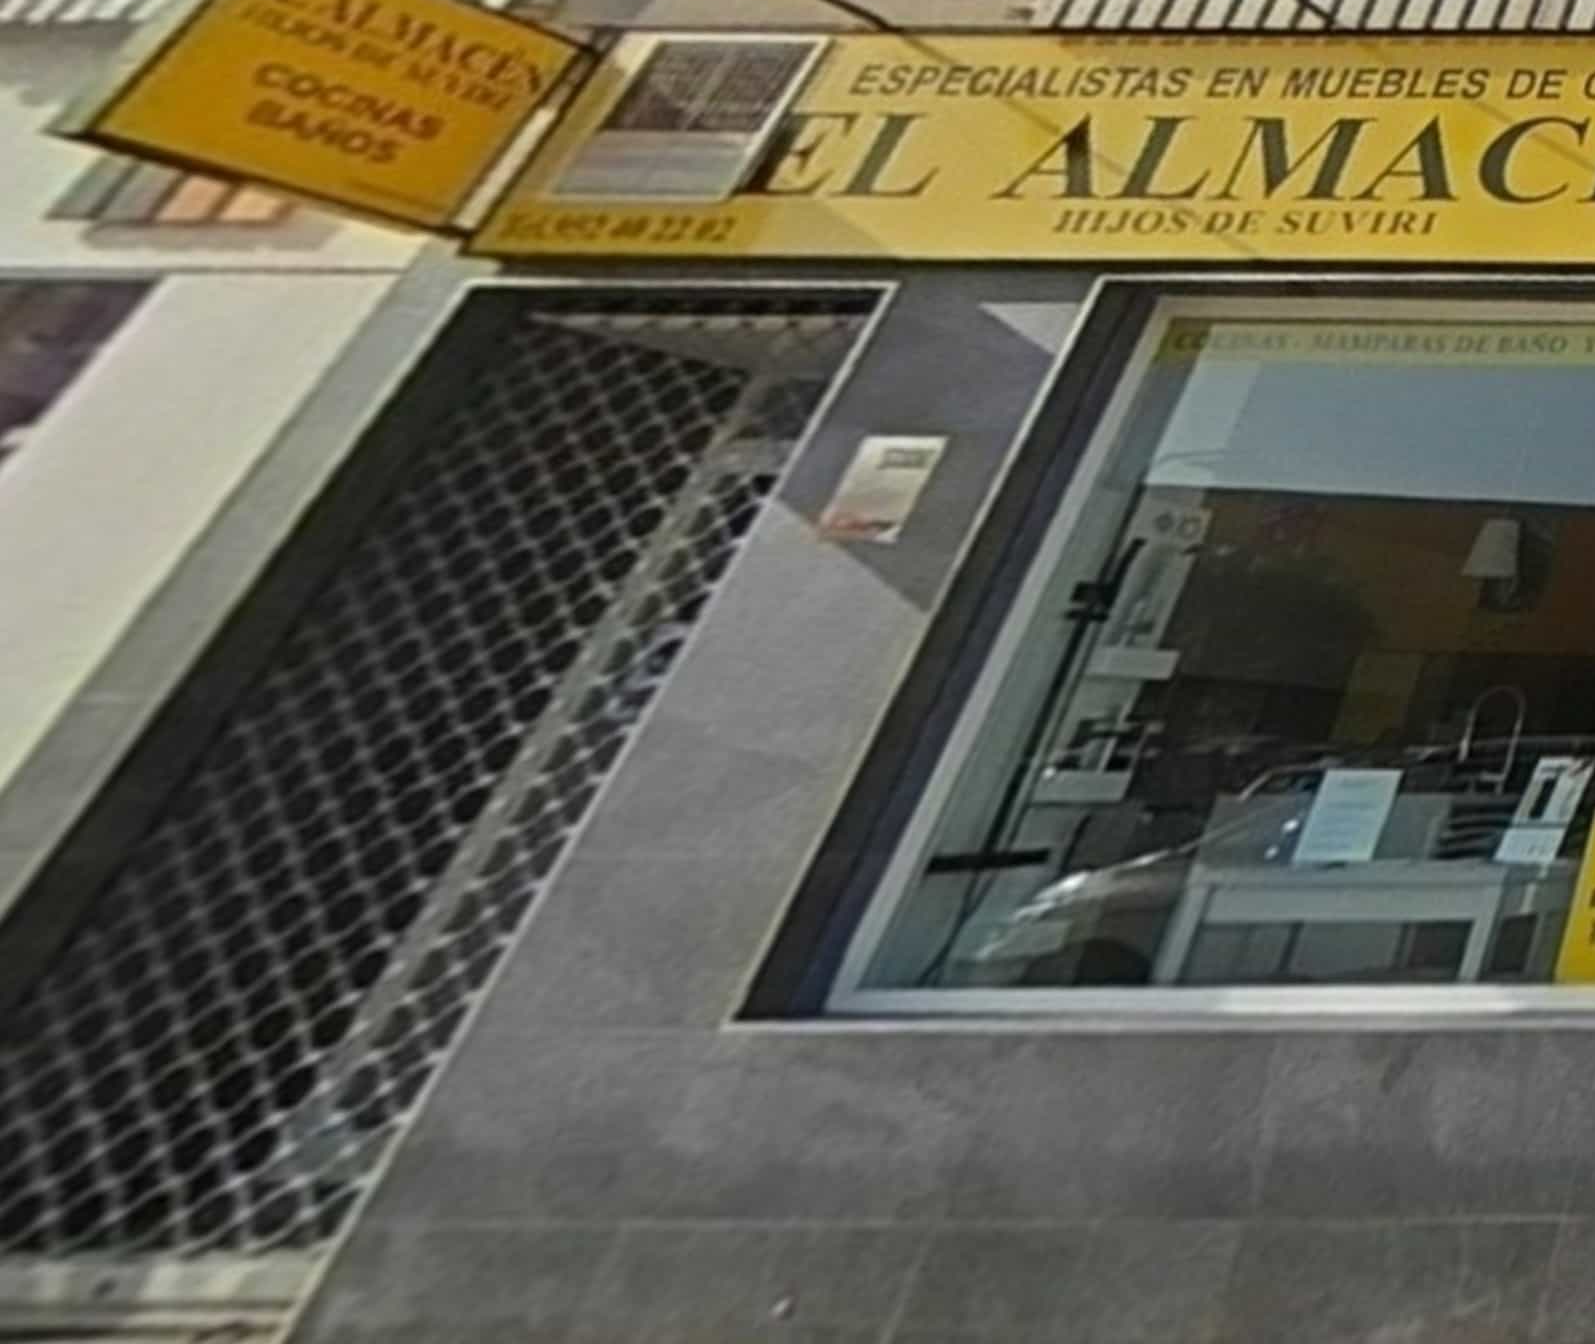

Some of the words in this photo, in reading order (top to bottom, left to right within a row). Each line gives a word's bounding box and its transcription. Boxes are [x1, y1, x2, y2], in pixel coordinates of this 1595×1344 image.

[850, 64, 1192, 99] ESPECIALISTAS
[1206, 66, 1269, 98] EN
[1281, 66, 1490, 99] MUEBLES
[1506, 68, 1567, 100] DE
[254, 63, 445, 141] COCINAS
[728, 110, 940, 198] EL
[1052, 208, 1199, 235] HIJOS
[1201, 209, 1269, 235] DE
[1274, 209, 1440, 235] SUVIRI
[1454, 333, 1491, 354] DE
[1496, 330, 1568, 354] BAÑO
